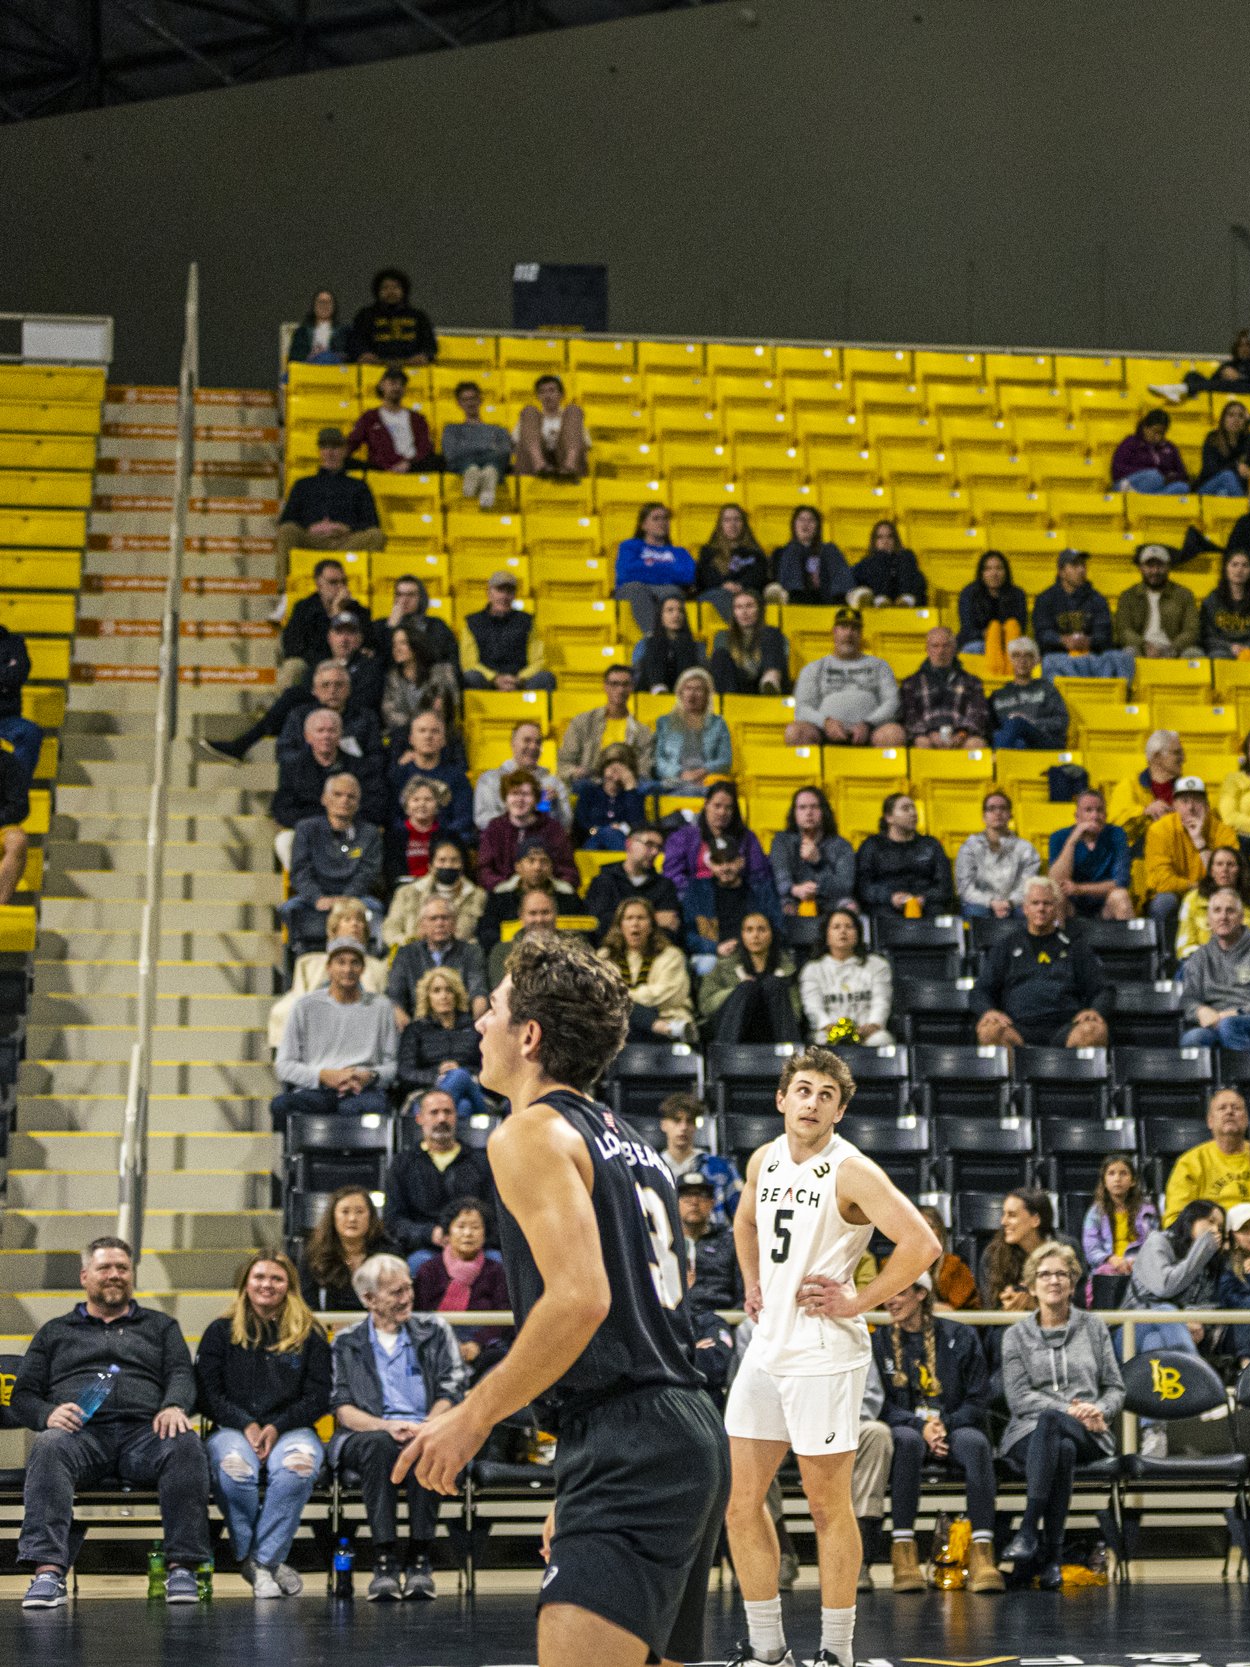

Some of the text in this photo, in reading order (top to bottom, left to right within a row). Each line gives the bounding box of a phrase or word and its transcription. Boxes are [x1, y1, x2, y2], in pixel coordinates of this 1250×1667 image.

[760, 1187, 820, 1208] BEACH
[770, 1209, 794, 1264] 5
[1149, 1358, 1185, 1400] LB
